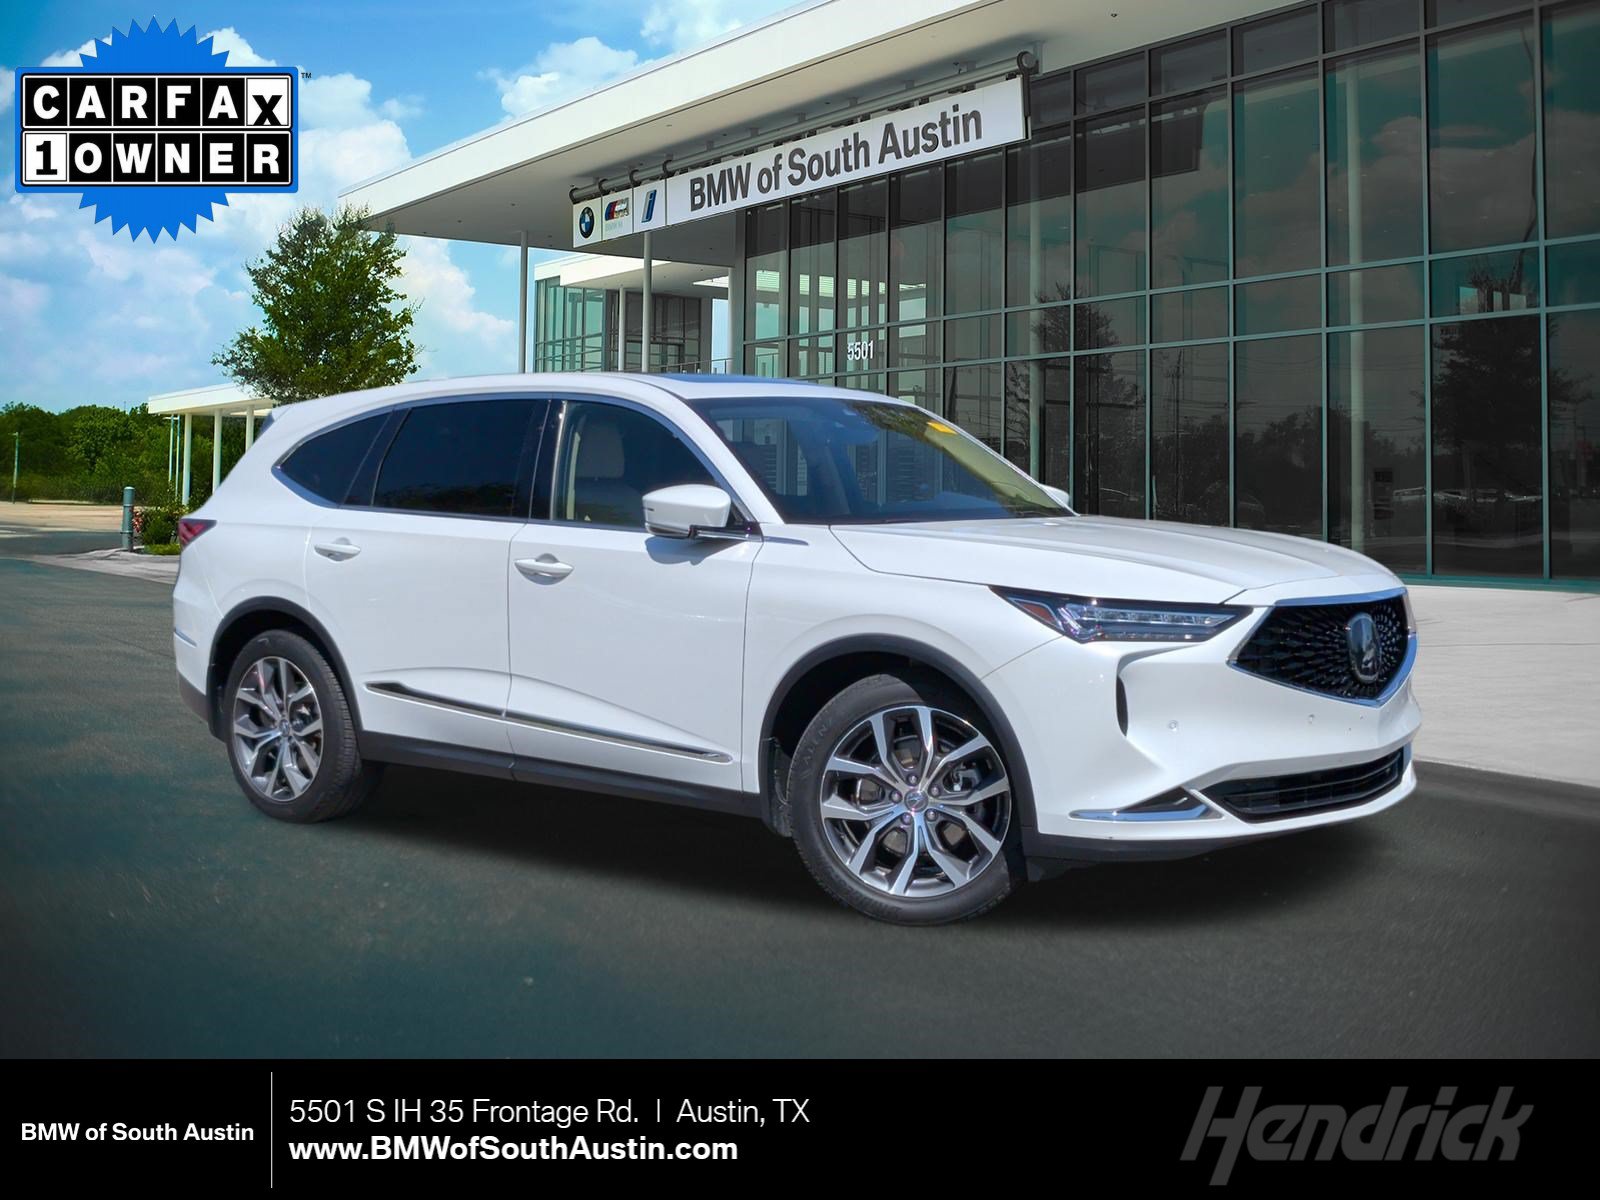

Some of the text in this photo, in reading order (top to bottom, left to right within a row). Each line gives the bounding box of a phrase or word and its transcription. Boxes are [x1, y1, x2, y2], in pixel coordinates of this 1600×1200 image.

[690, 103, 983, 212] BMW of South Austin
[847, 340, 873, 360] 5501
